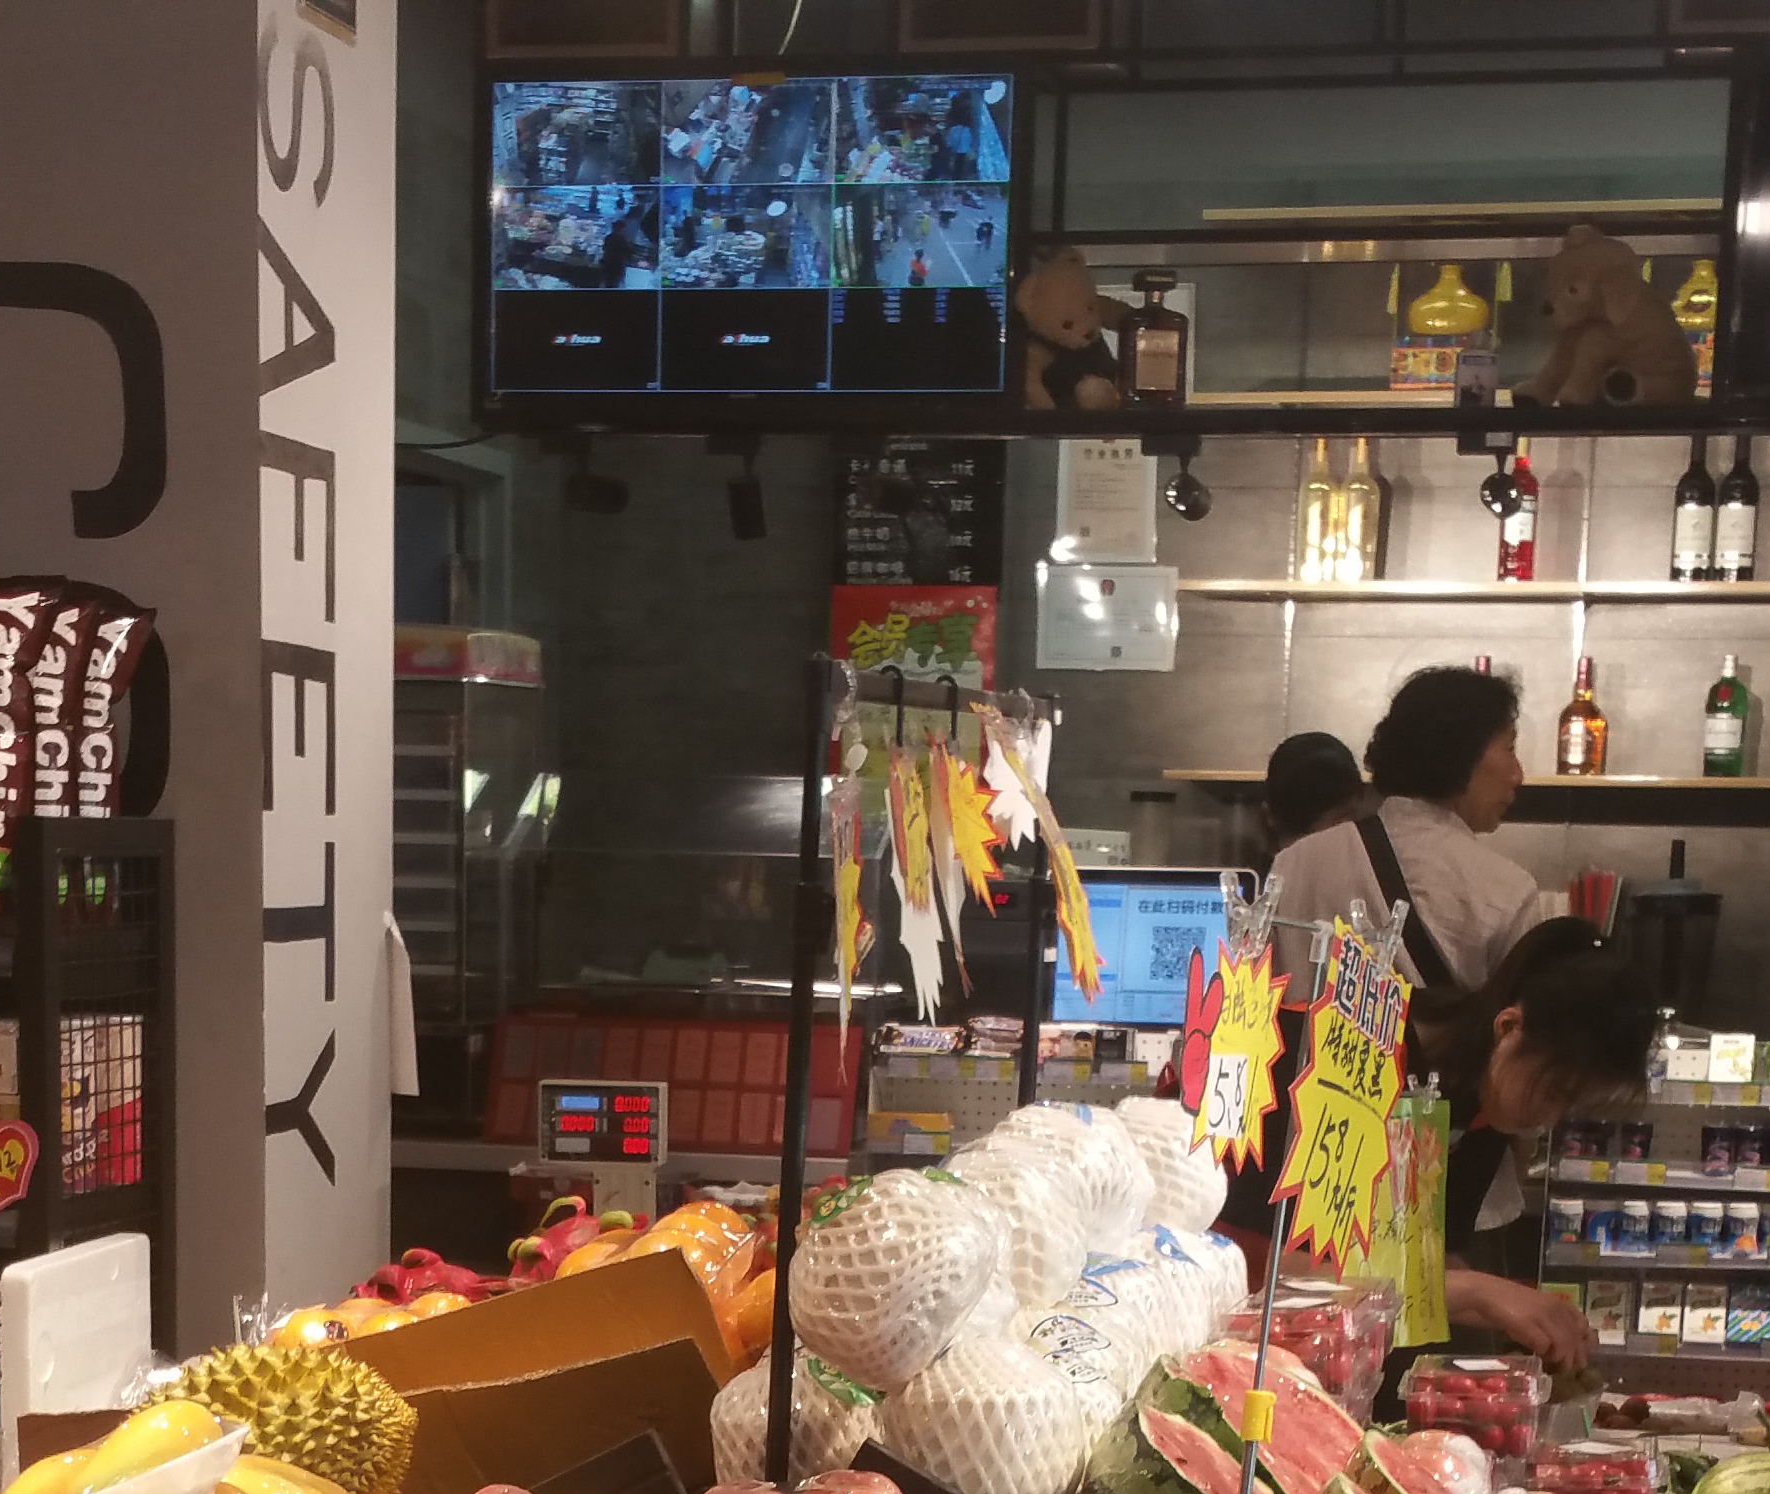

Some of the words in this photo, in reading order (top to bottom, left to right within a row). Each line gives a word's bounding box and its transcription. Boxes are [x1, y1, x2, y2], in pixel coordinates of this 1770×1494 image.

[26, 607, 80, 818] YamChi
[260, 38, 336, 1186] SAFETY
[79, 617, 139, 819] YamChi
